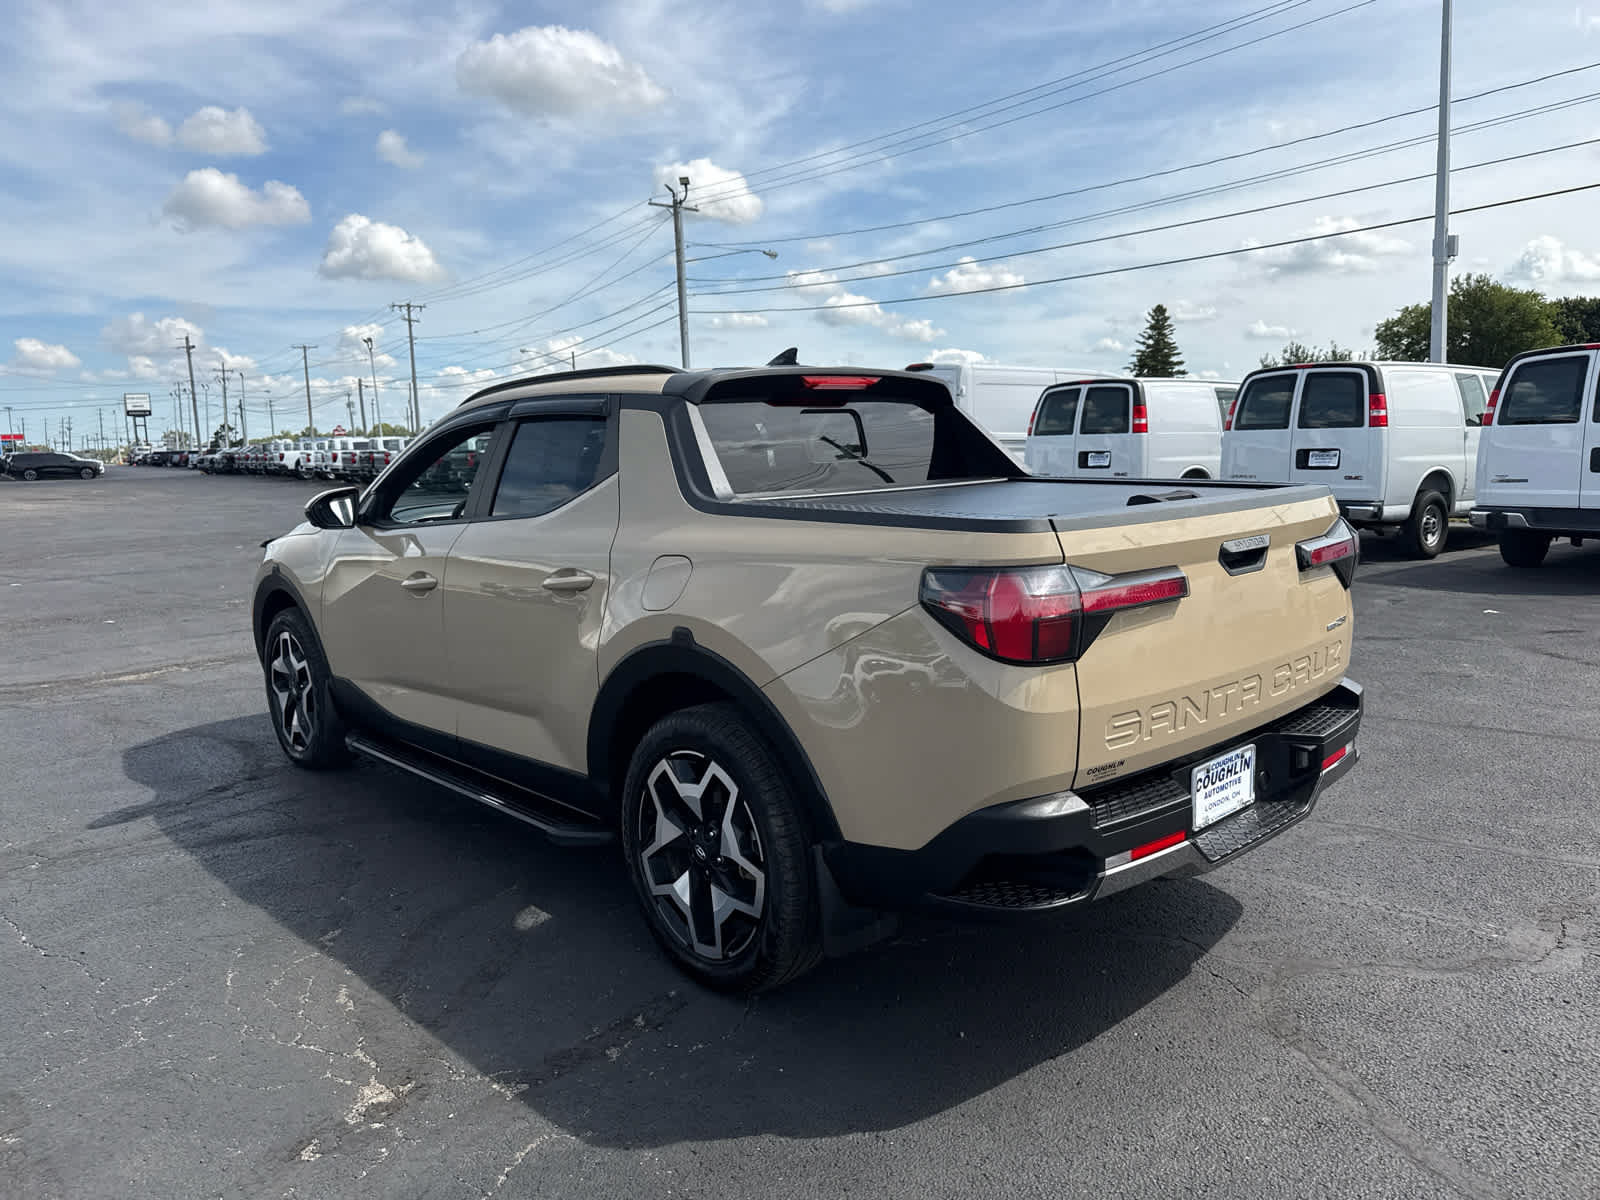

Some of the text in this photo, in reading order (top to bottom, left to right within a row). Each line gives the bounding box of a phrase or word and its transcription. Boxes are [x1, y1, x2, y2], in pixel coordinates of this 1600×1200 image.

[1104, 639, 1343, 750] SANTA CRUZ
[1211, 752, 1241, 771] COUGHLIN
[1196, 756, 1252, 793] COUGHLIN
[1204, 775, 1242, 800] AUTOMOTIVE
[1231, 789, 1241, 799] OH
